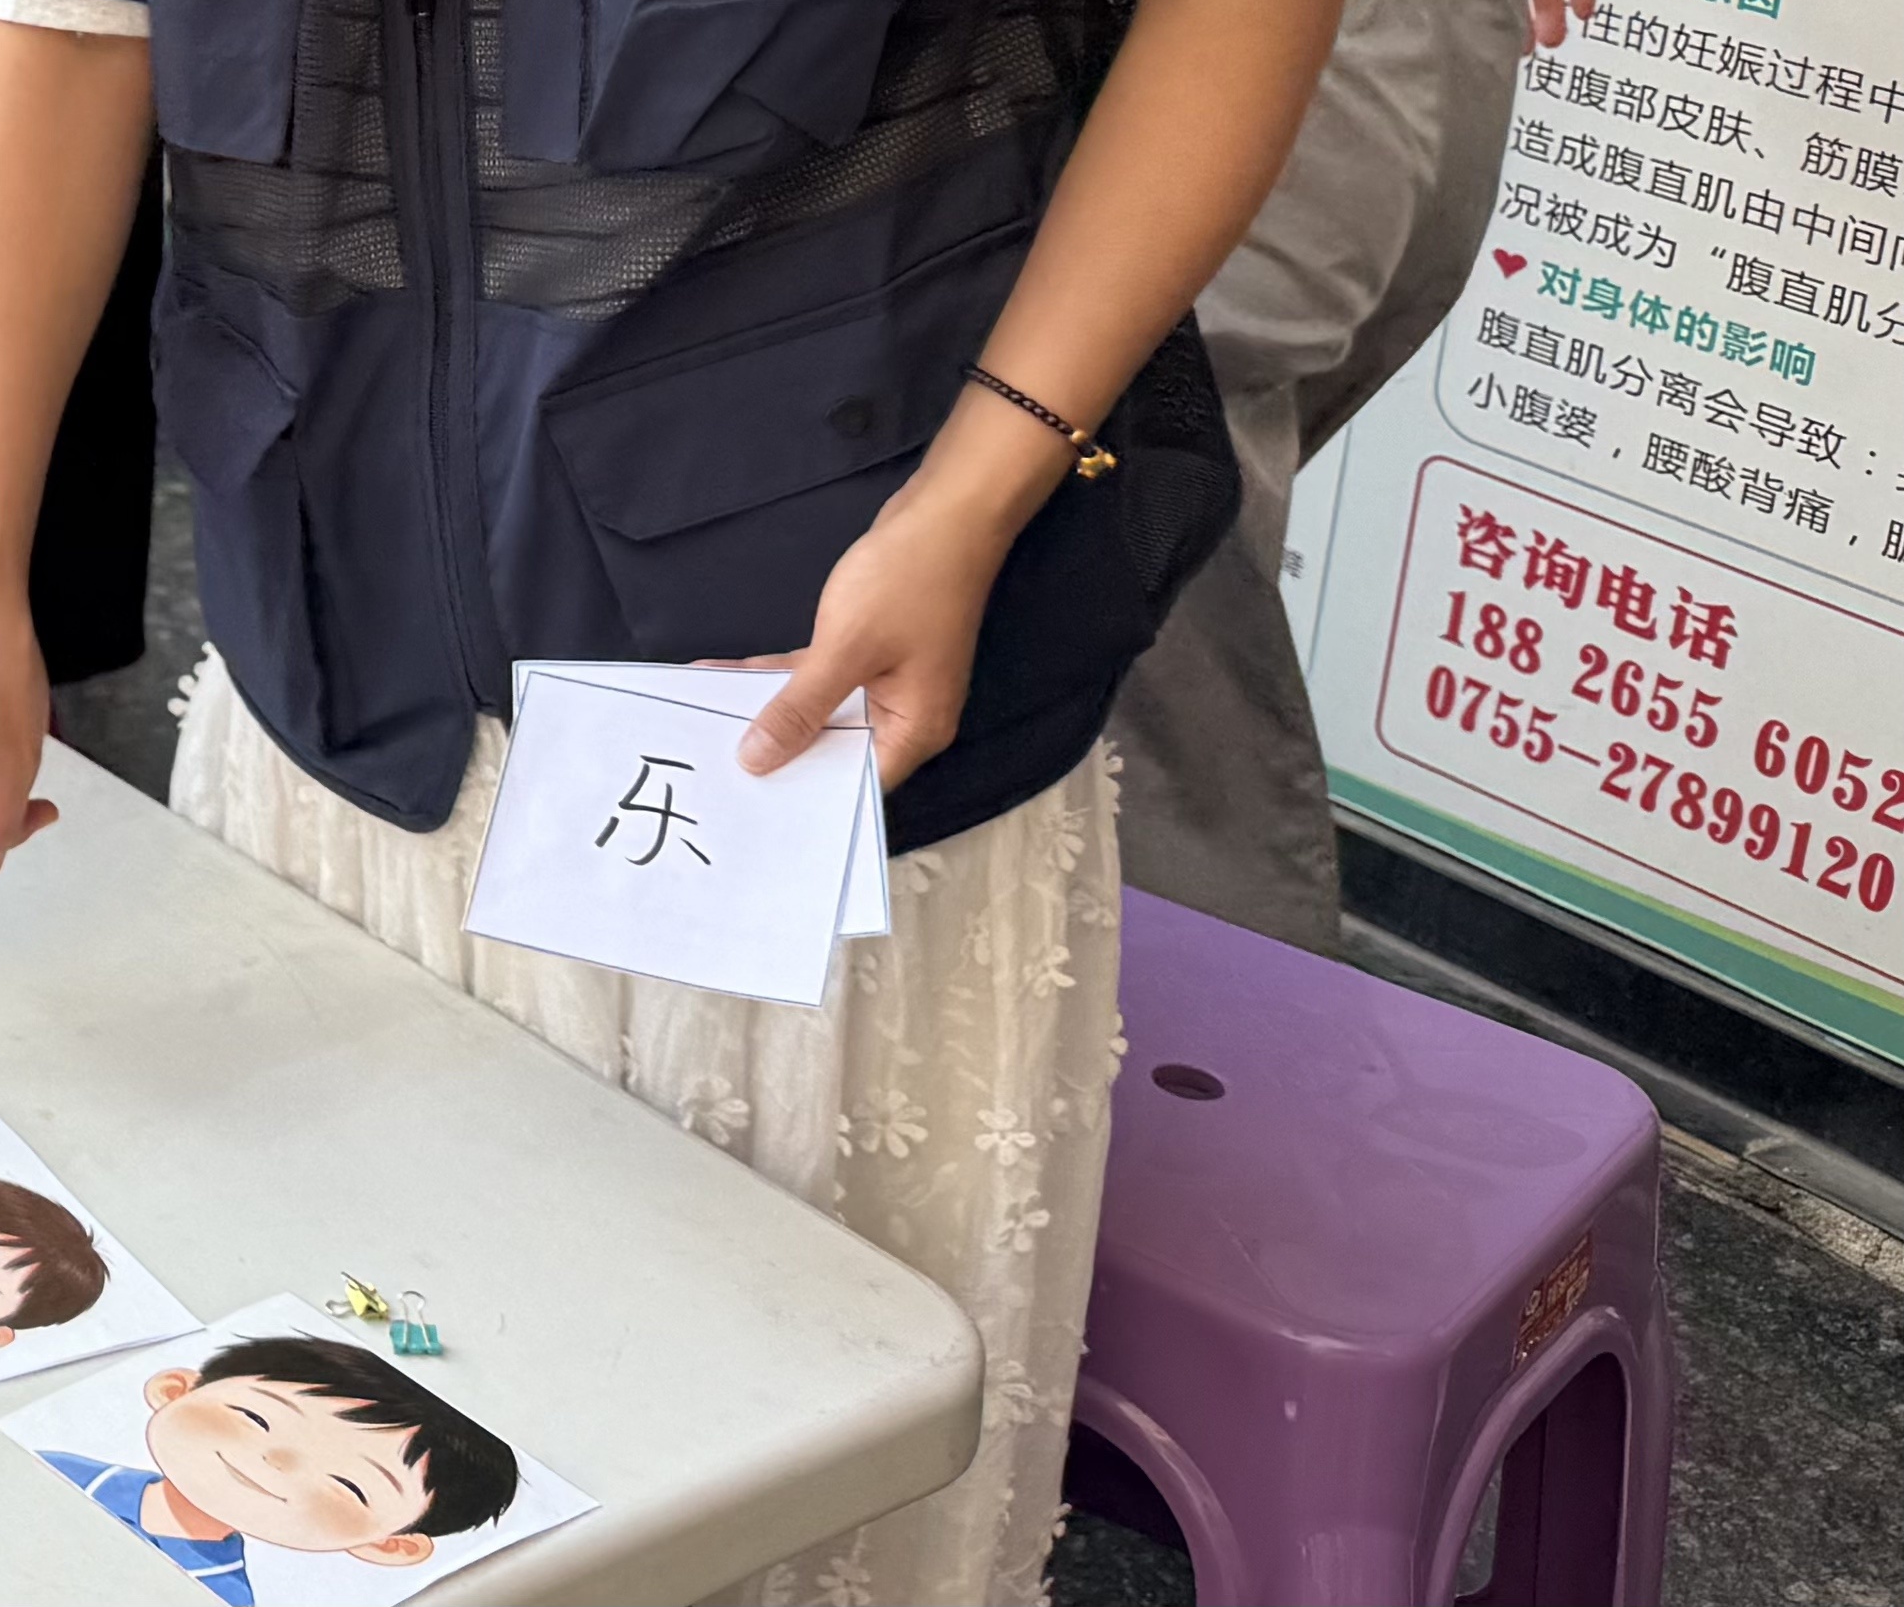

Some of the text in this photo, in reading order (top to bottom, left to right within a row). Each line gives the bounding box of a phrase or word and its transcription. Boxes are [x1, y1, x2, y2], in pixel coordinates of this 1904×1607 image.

[1477, 306, 1904, 492] 腹直肌分离会导致：
[1536, 260, 1817, 386] 对身体的影响
[1455, 503, 1738, 670] 咨询电话
[1439, 590, 1904, 834] 188 2655 6052
[593, 753, 713, 867] 乐
